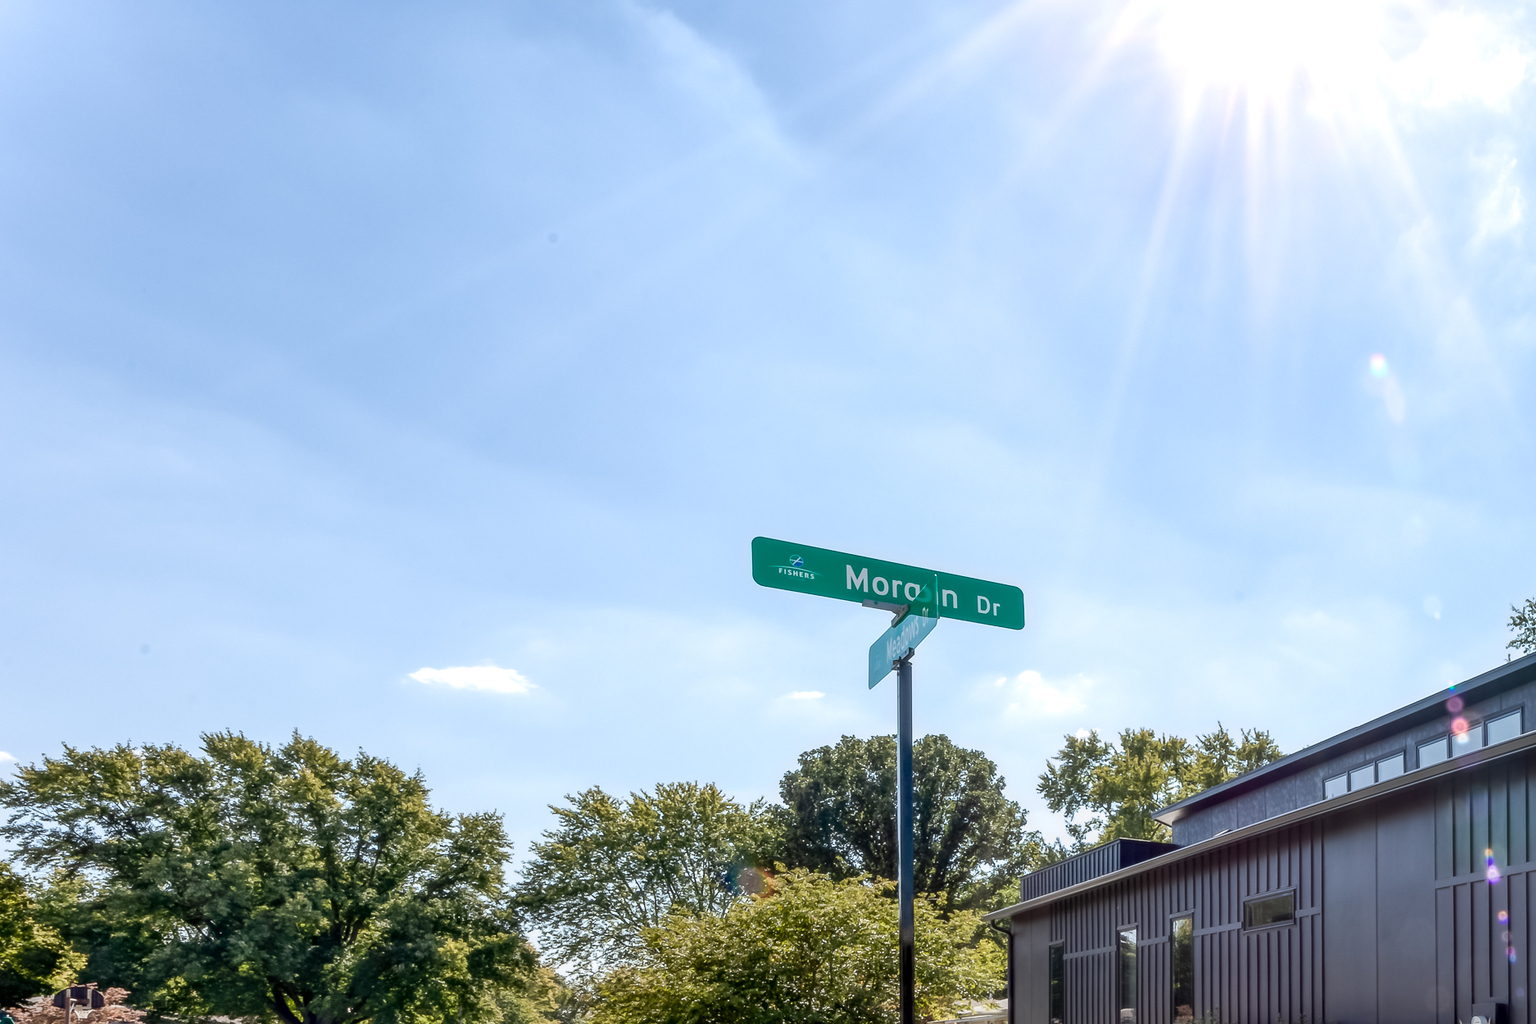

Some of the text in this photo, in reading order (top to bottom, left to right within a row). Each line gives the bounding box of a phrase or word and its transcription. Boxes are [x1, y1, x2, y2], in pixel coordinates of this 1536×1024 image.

[778, 567, 815, 580] FISHERS
[845, 564, 1000, 616] Morgn Dr
[886, 615, 919, 664] Meadows
